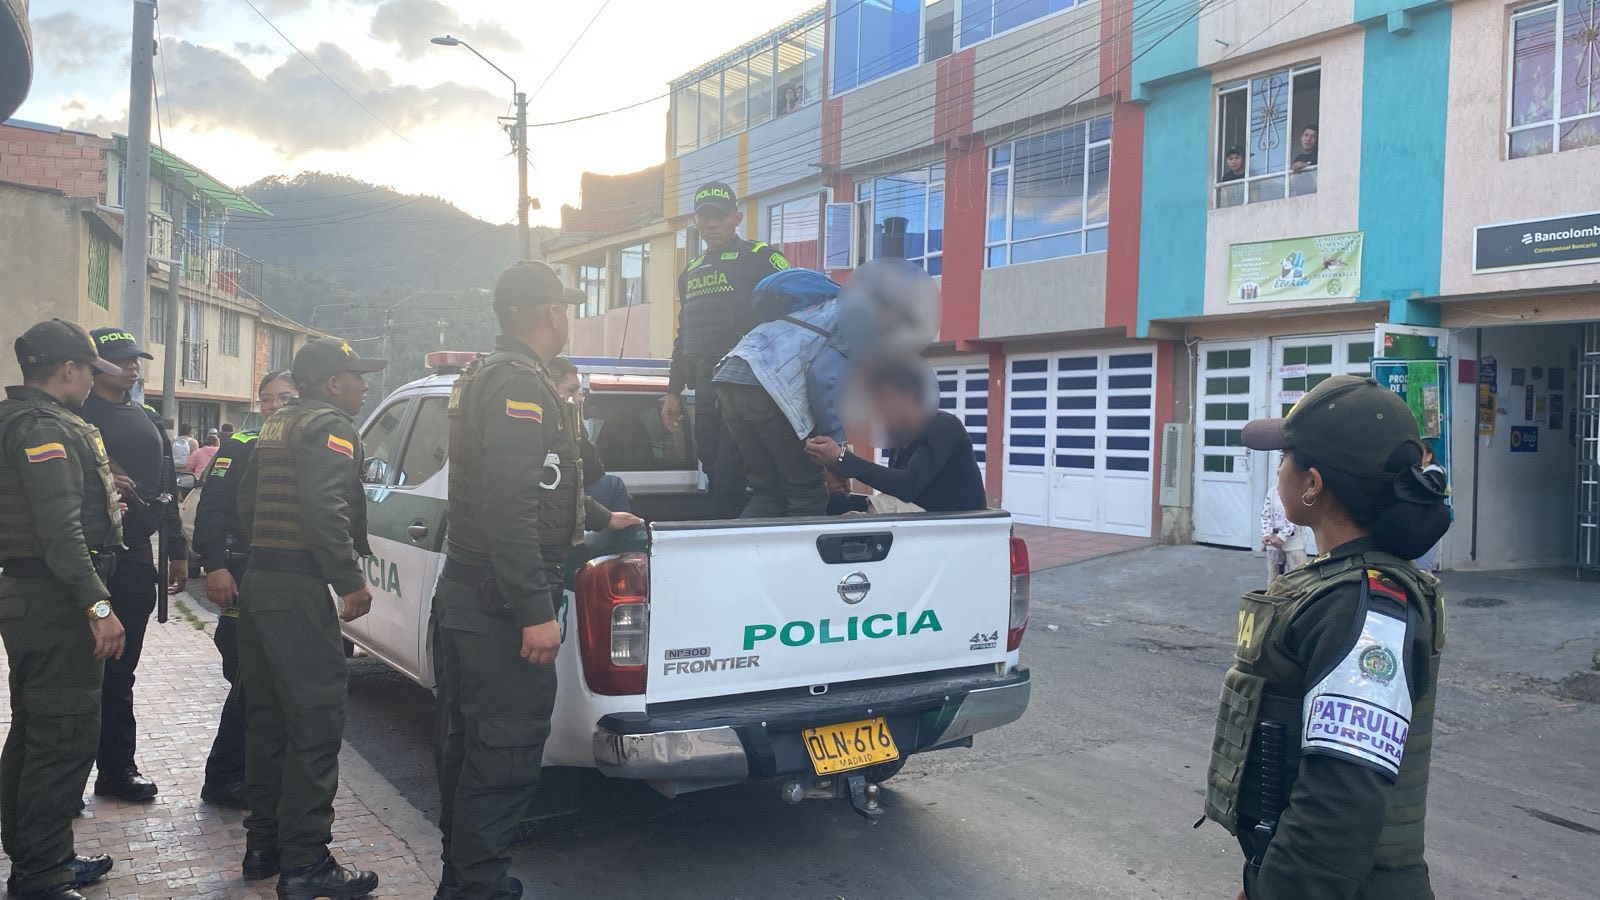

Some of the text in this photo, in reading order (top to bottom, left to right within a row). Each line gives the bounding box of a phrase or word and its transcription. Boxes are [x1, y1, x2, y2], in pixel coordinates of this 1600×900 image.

[1534, 226, 1600, 242] Bancolomb
[743, 609, 943, 651] POLICIA
[668, 647, 709, 659] NP300
[663, 655, 760, 676] FRONTIER
[1313, 701, 1408, 745] PATRULLA
[1311, 721, 1402, 760] PÚRPURA
[840, 753, 873, 767] MADRID
